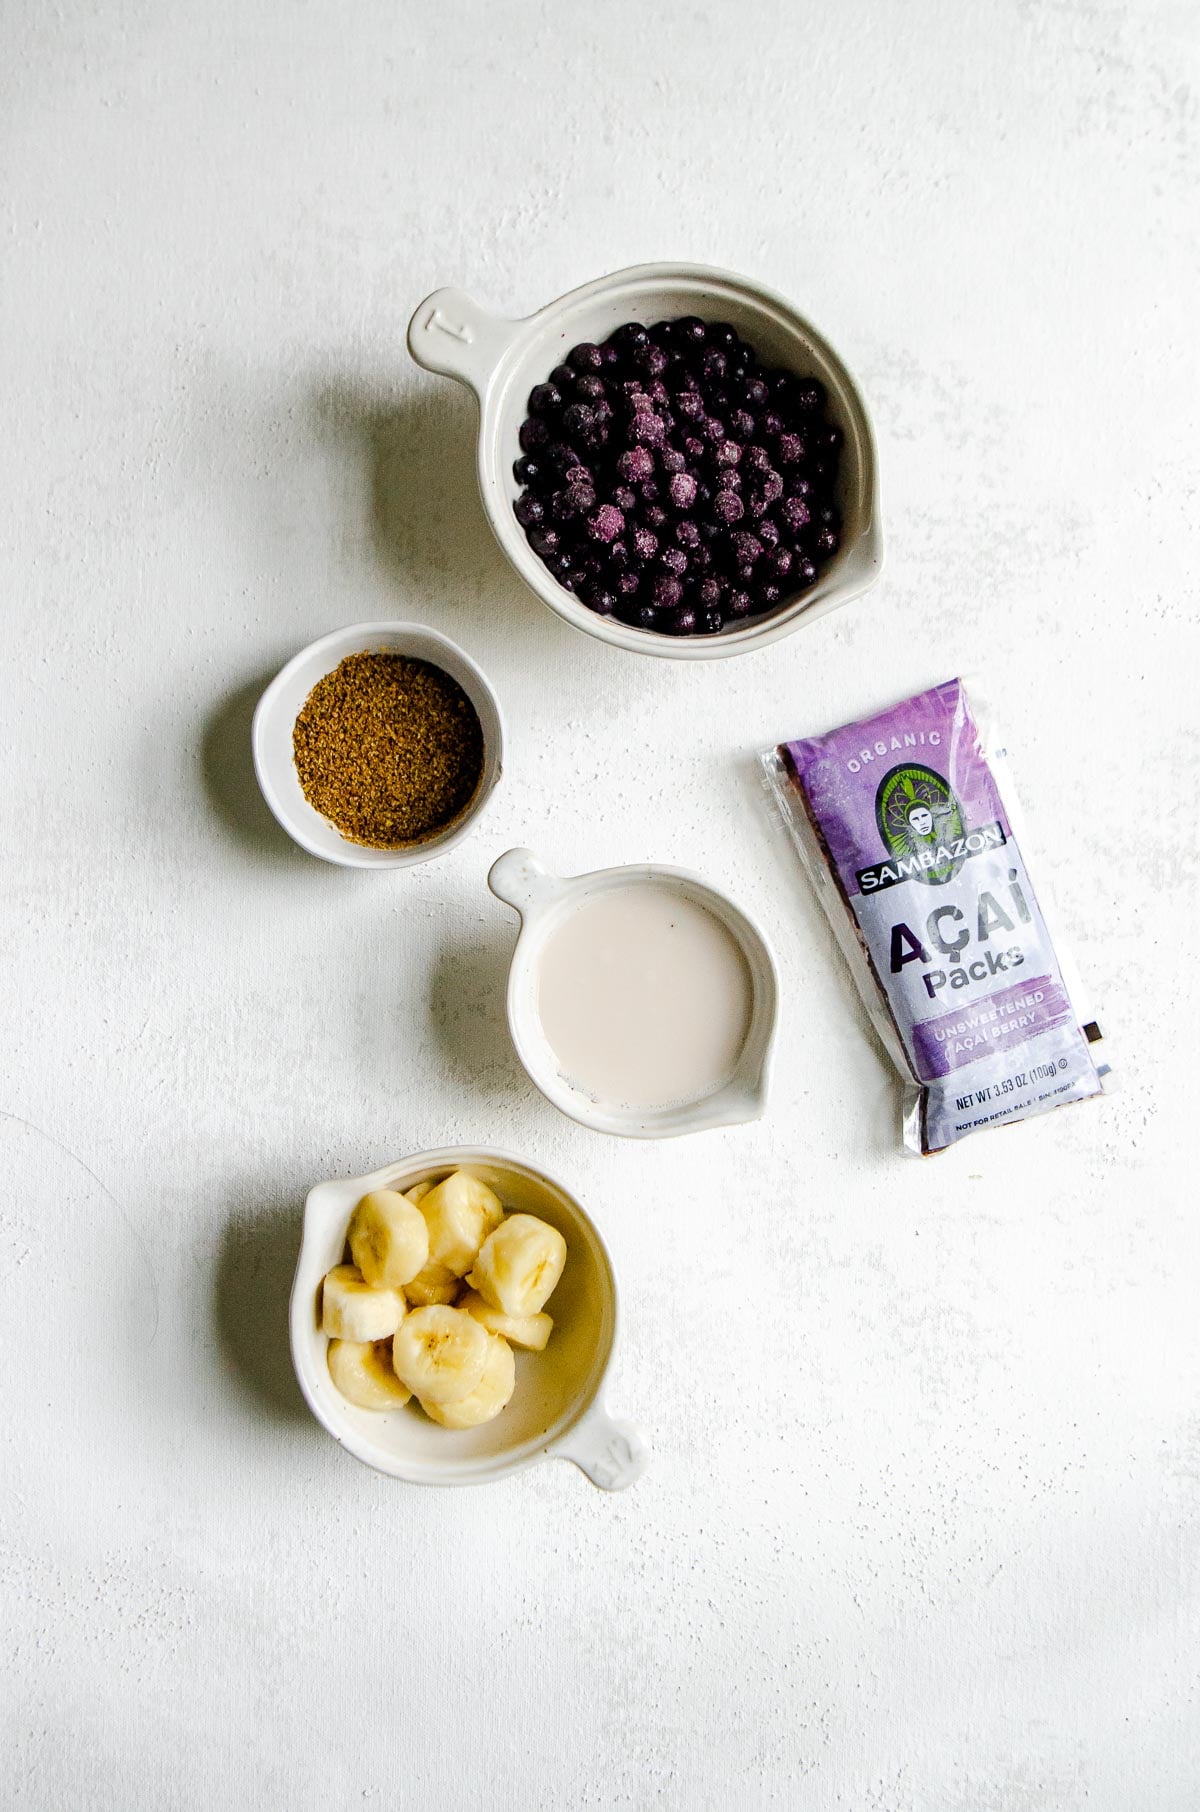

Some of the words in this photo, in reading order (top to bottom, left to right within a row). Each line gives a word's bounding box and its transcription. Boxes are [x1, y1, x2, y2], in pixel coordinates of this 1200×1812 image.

[846, 730, 942, 774] ORGANIC
[861, 827, 1003, 889] SAMBAZON
[922, 945, 1026, 999] Packs
[934, 990, 1045, 1042] UNSWEETENED
[954, 1032, 989, 1053] AÇAÍ
[991, 1012, 1037, 1039] BERRY
[955, 1094, 974, 1111] NET
[975, 1087, 992, 1104] WT
[993, 1079, 1014, 1097] 3.53
[1014, 1073, 1028, 1088] OZ
[1029, 1061, 1057, 1085] (100g)
[955, 1122, 973, 1132] NOT
[973, 1116, 989, 1127] FOR
[990, 1108, 1013, 1121] RETAIL
